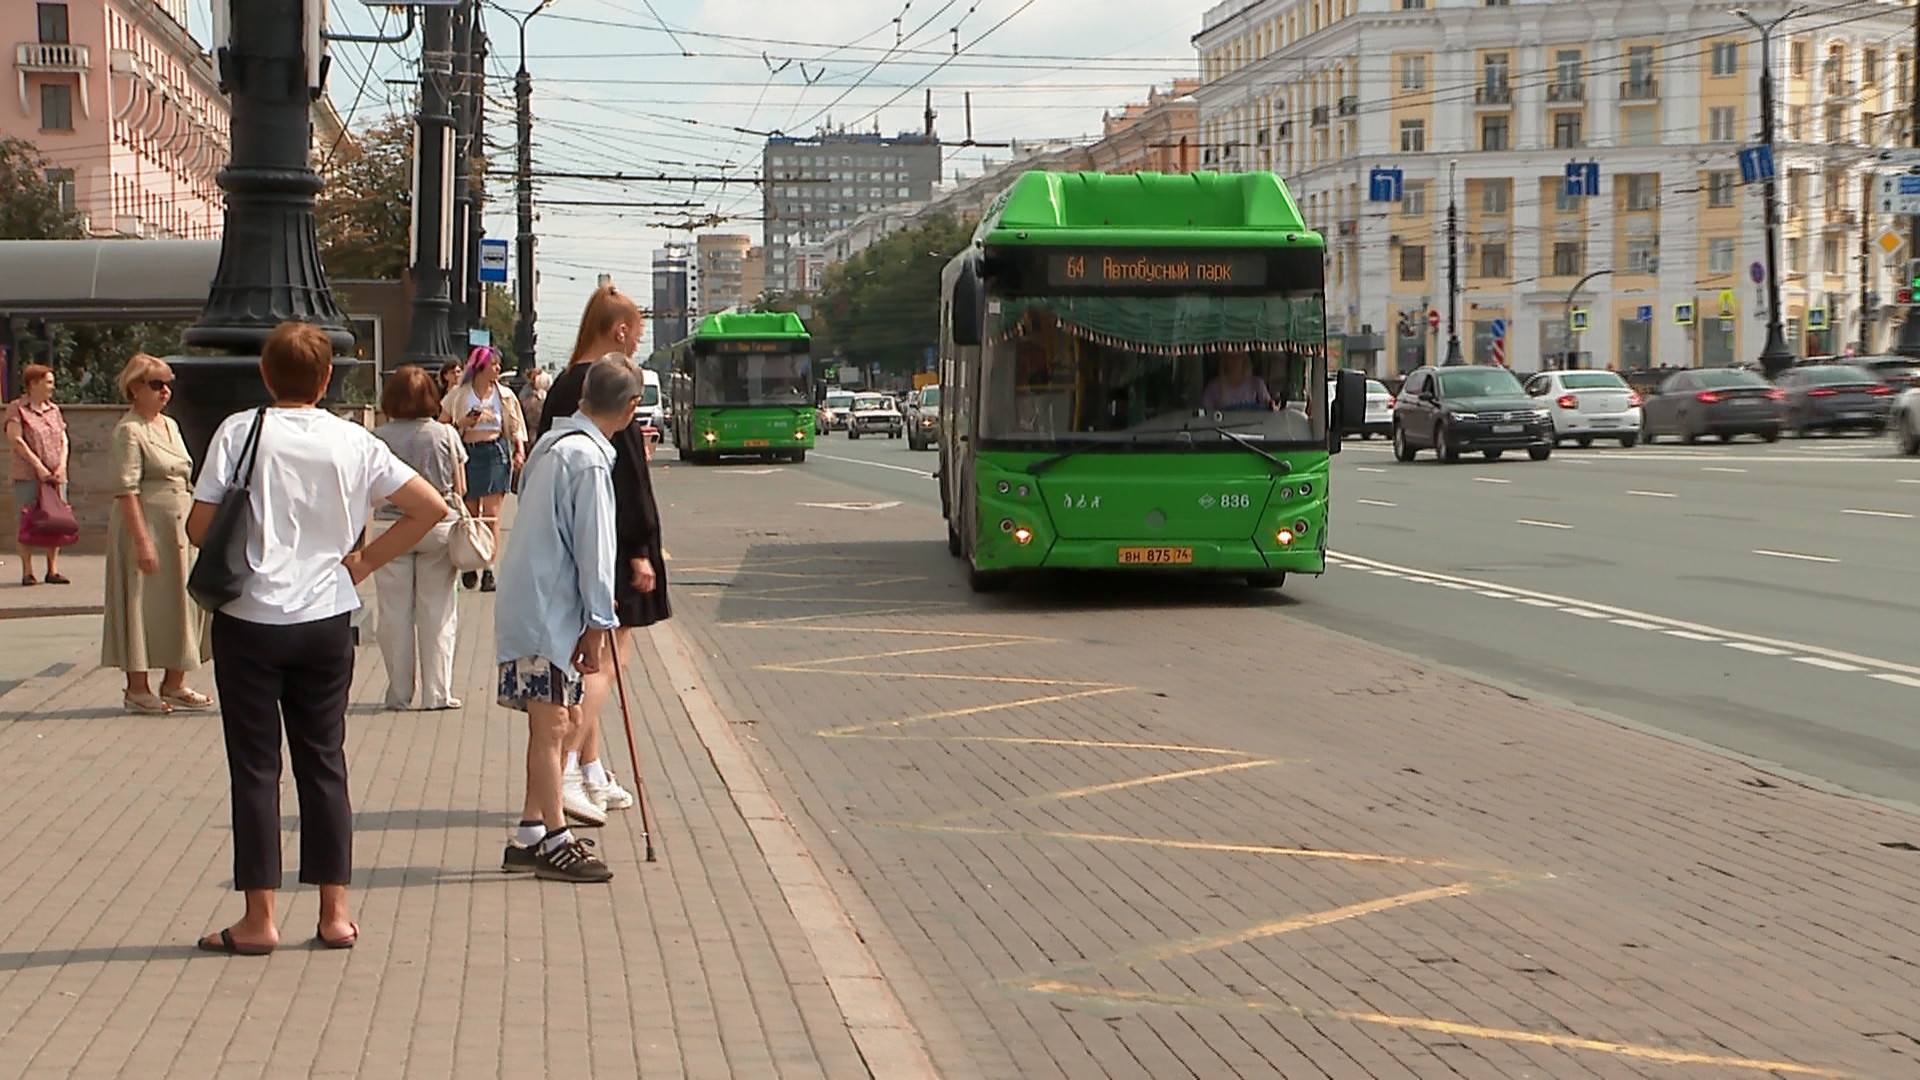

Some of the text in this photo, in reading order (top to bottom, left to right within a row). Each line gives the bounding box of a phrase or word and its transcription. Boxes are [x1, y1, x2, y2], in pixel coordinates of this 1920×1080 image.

[1067, 256, 1231, 281] 64 Автобусный парк
[1220, 494, 1250, 508] 836
[1147, 549, 1171, 562] 875
[1176, 548, 1188, 559] 74
